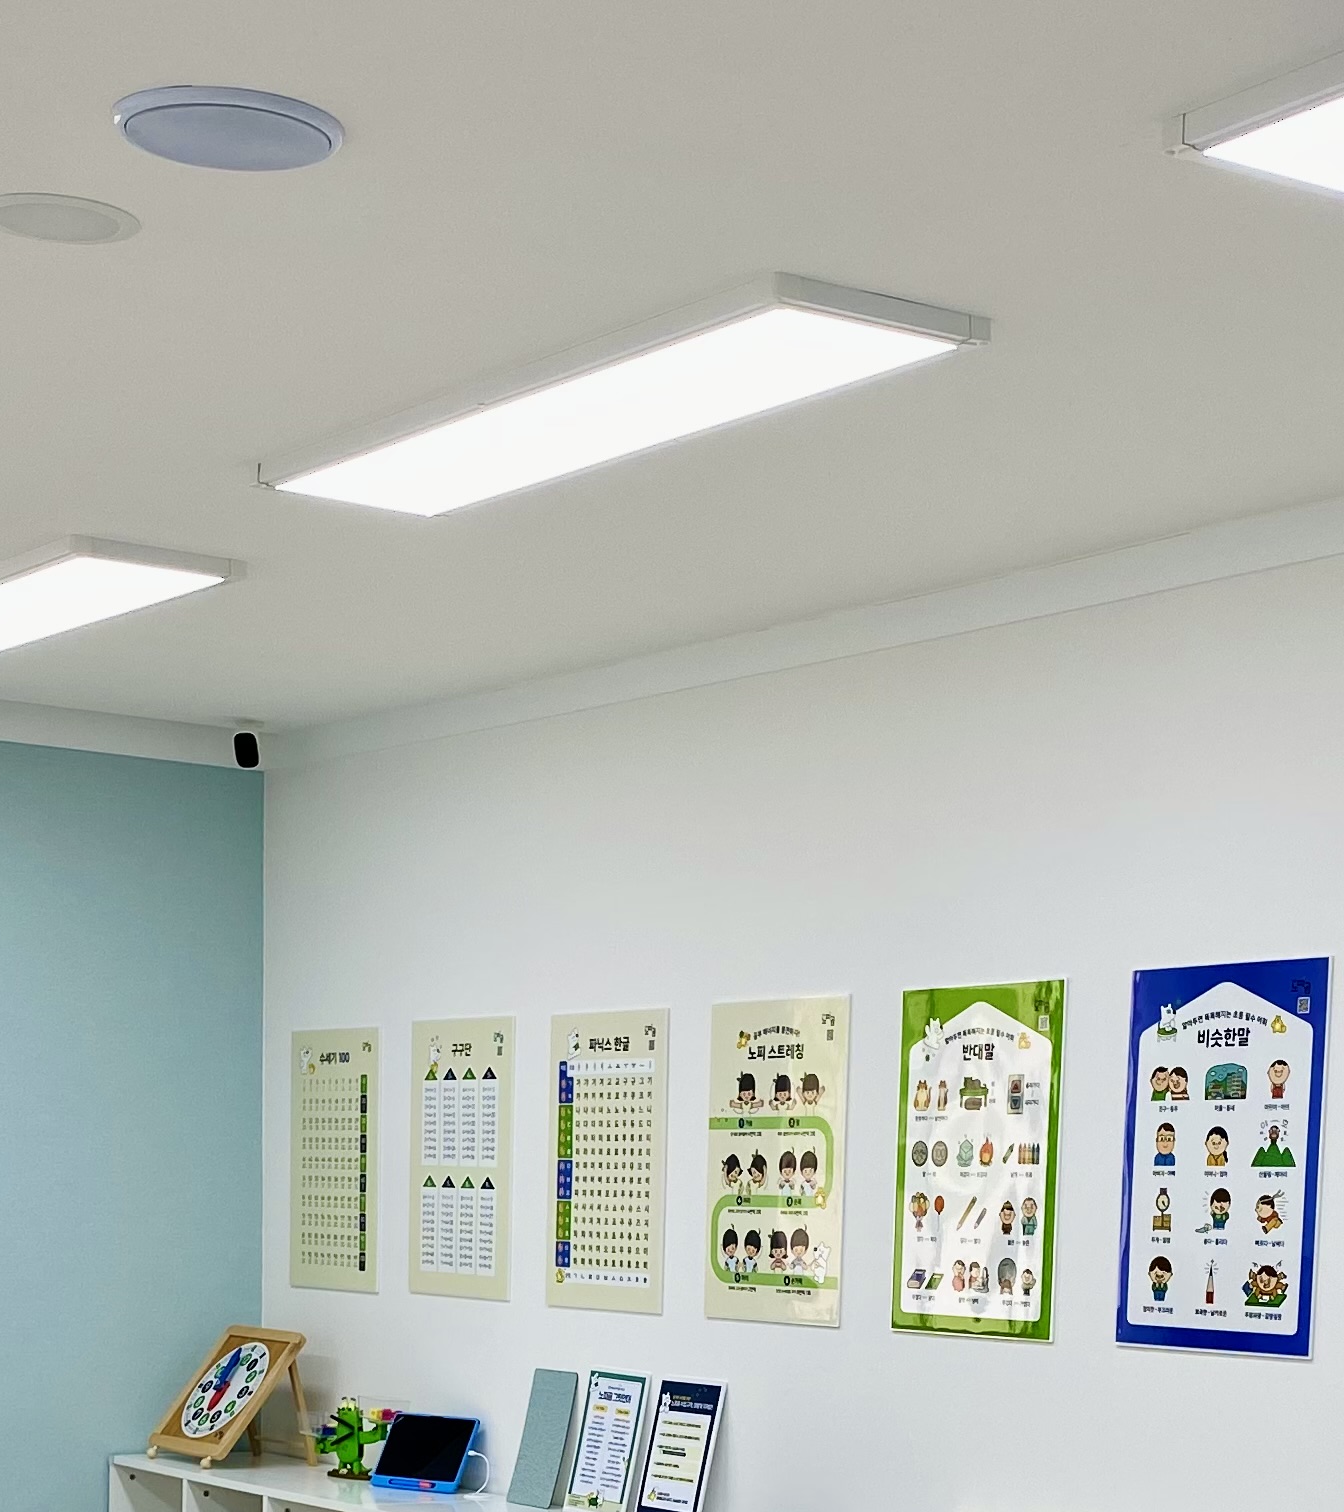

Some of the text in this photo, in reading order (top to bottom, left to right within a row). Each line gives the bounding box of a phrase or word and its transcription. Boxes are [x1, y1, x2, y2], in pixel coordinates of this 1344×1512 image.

[589, 1036, 630, 1052] 파닉스 한글
[1197, 1026, 1251, 1048] 비슷한말
[451, 1043, 472, 1057] 구구단
[748, 1043, 805, 1061] 노피 스트레칭
[962, 1043, 995, 1061] 반대말
[319, 1052, 350, 1066] 수세기 100
